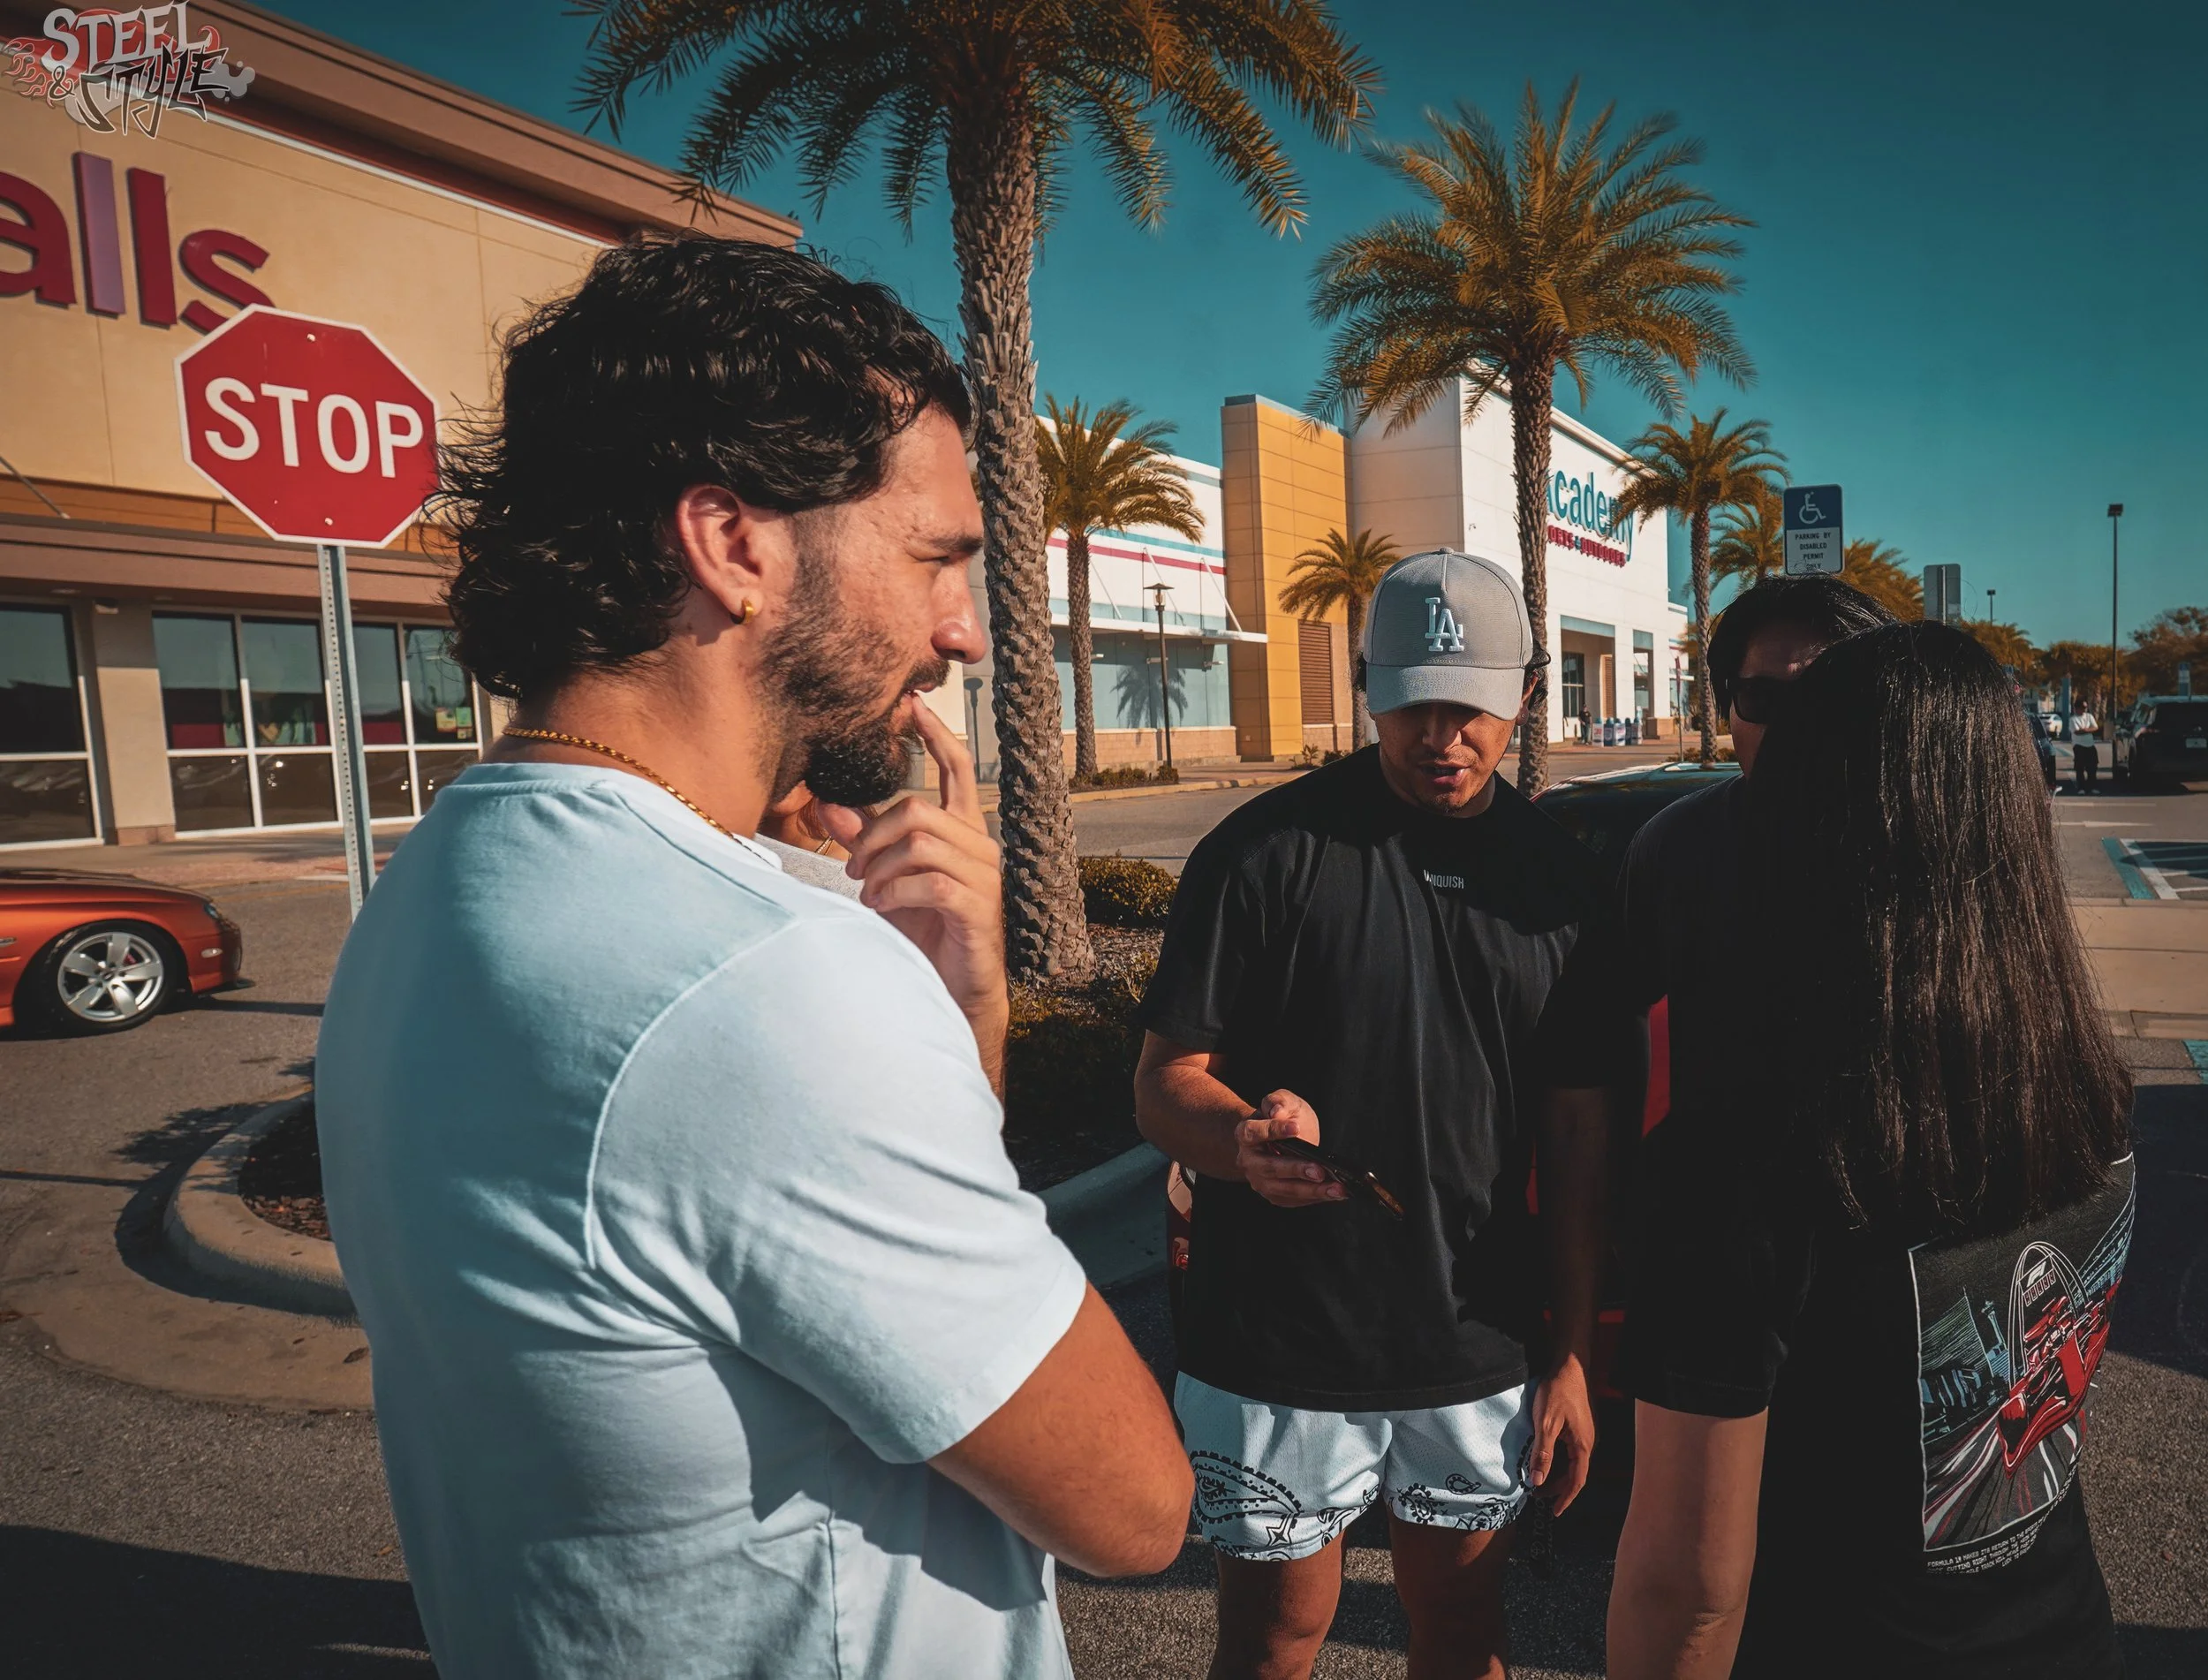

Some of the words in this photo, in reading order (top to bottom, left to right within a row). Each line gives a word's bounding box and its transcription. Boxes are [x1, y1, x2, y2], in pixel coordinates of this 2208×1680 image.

[204, 376, 424, 479] STOP
[1425, 597, 1464, 652] LA
[1423, 869, 1464, 889] VNQUISH
[1927, 1558, 1954, 1568] FORMULA
[1962, 1550, 1979, 1561] MAKES
[1991, 1540, 2009, 1551] RETURN
[1947, 1562, 1970, 1571] CUTTING
[1972, 1555, 1987, 1566] RIGHT
[1981, 1560, 1995, 1570] TRACK
